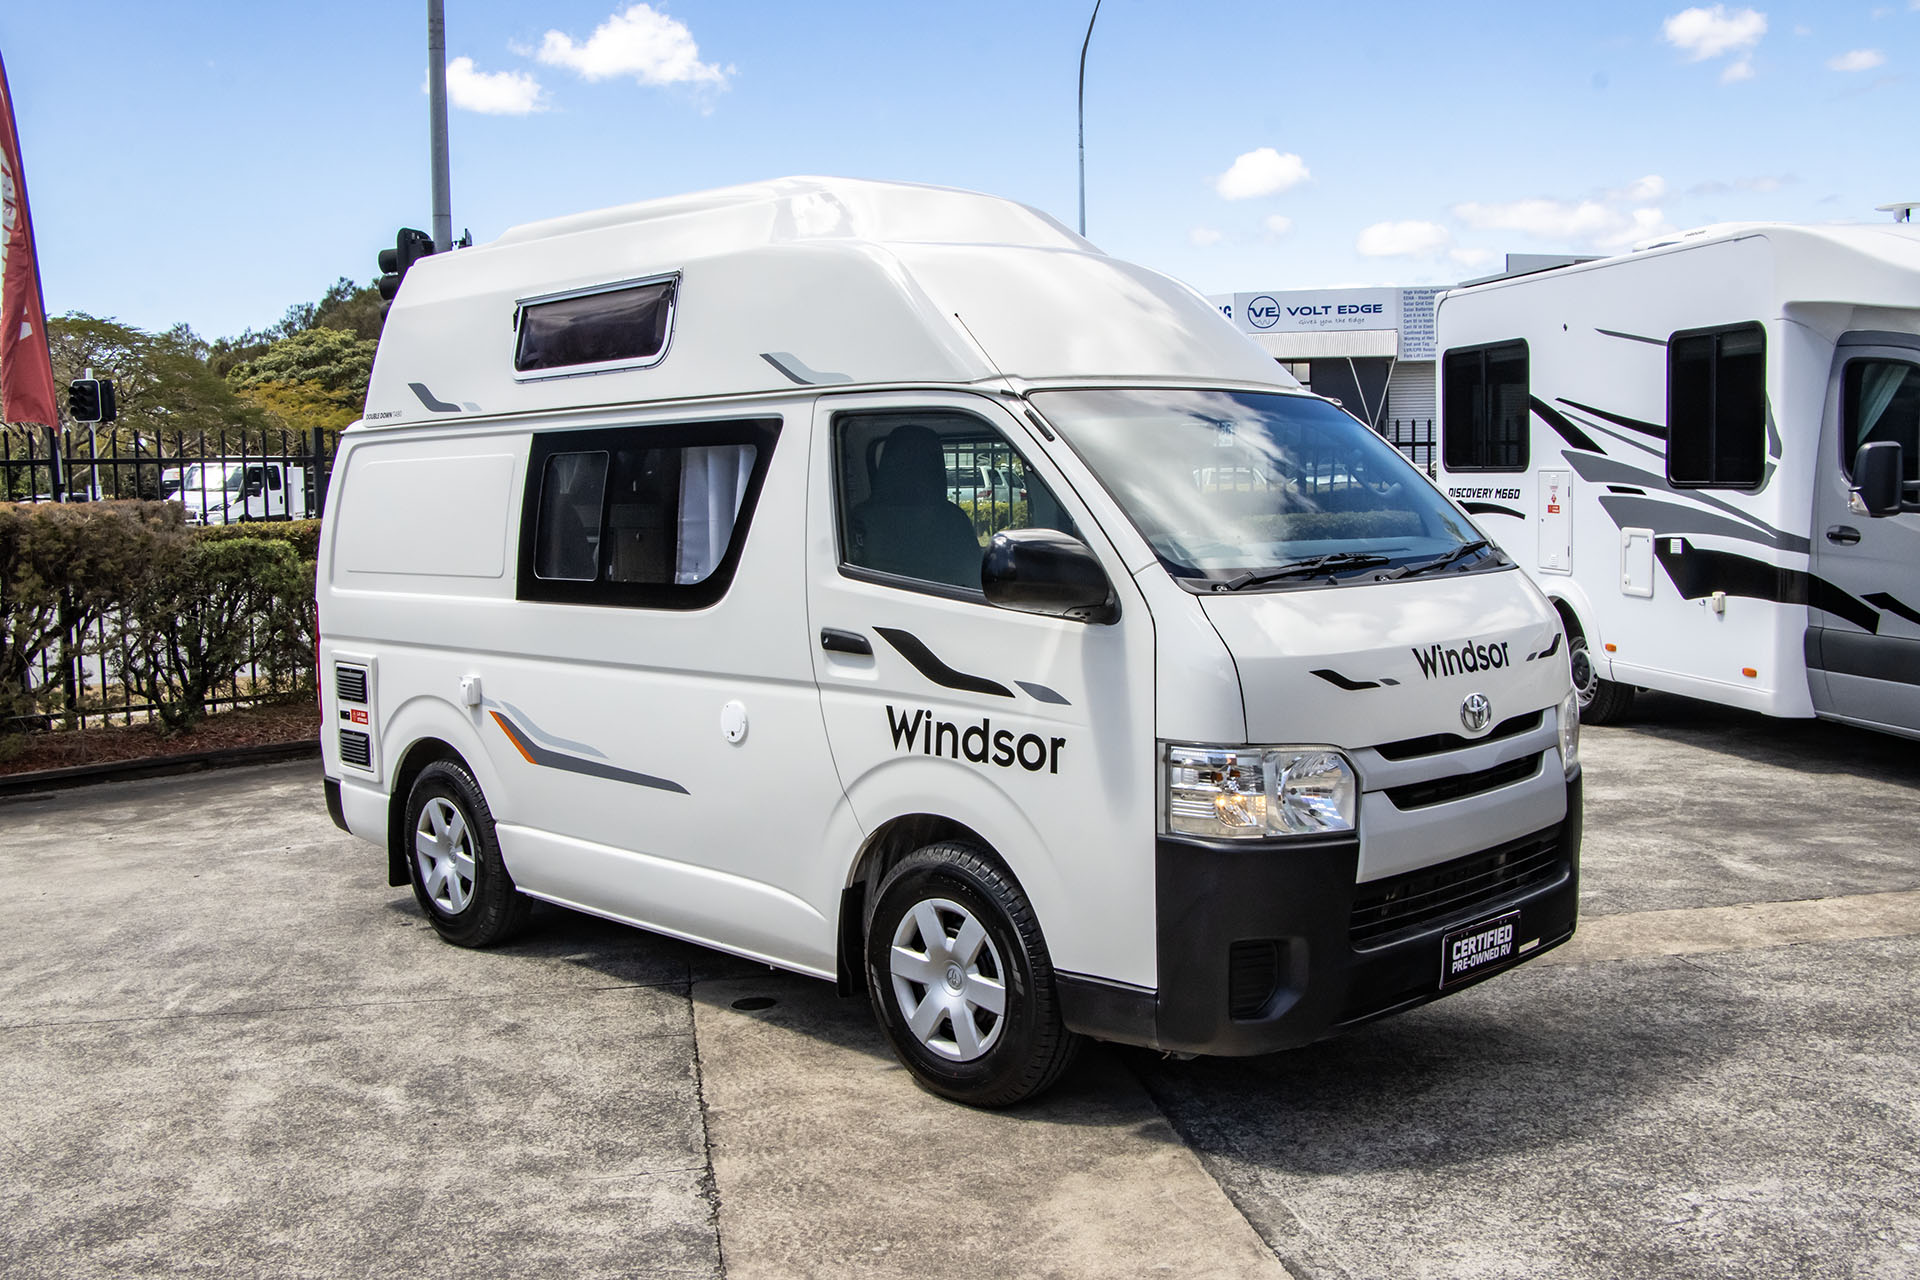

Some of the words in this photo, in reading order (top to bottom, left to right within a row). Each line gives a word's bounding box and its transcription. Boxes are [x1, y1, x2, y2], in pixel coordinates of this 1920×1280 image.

[1286, 305, 1332, 316] VOLT
[1338, 304, 1383, 314] EDGE
[1448, 488, 1493, 498] DISCOVERY
[1494, 488, 1520, 499] M660
[1411, 640, 1510, 680] Windsor
[886, 705, 1066, 774] Windsor
[1452, 924, 1512, 960] CERTIFIED
[1452, 946, 1500, 974] PRE-OWNED
[1500, 942, 1512, 956] RV
